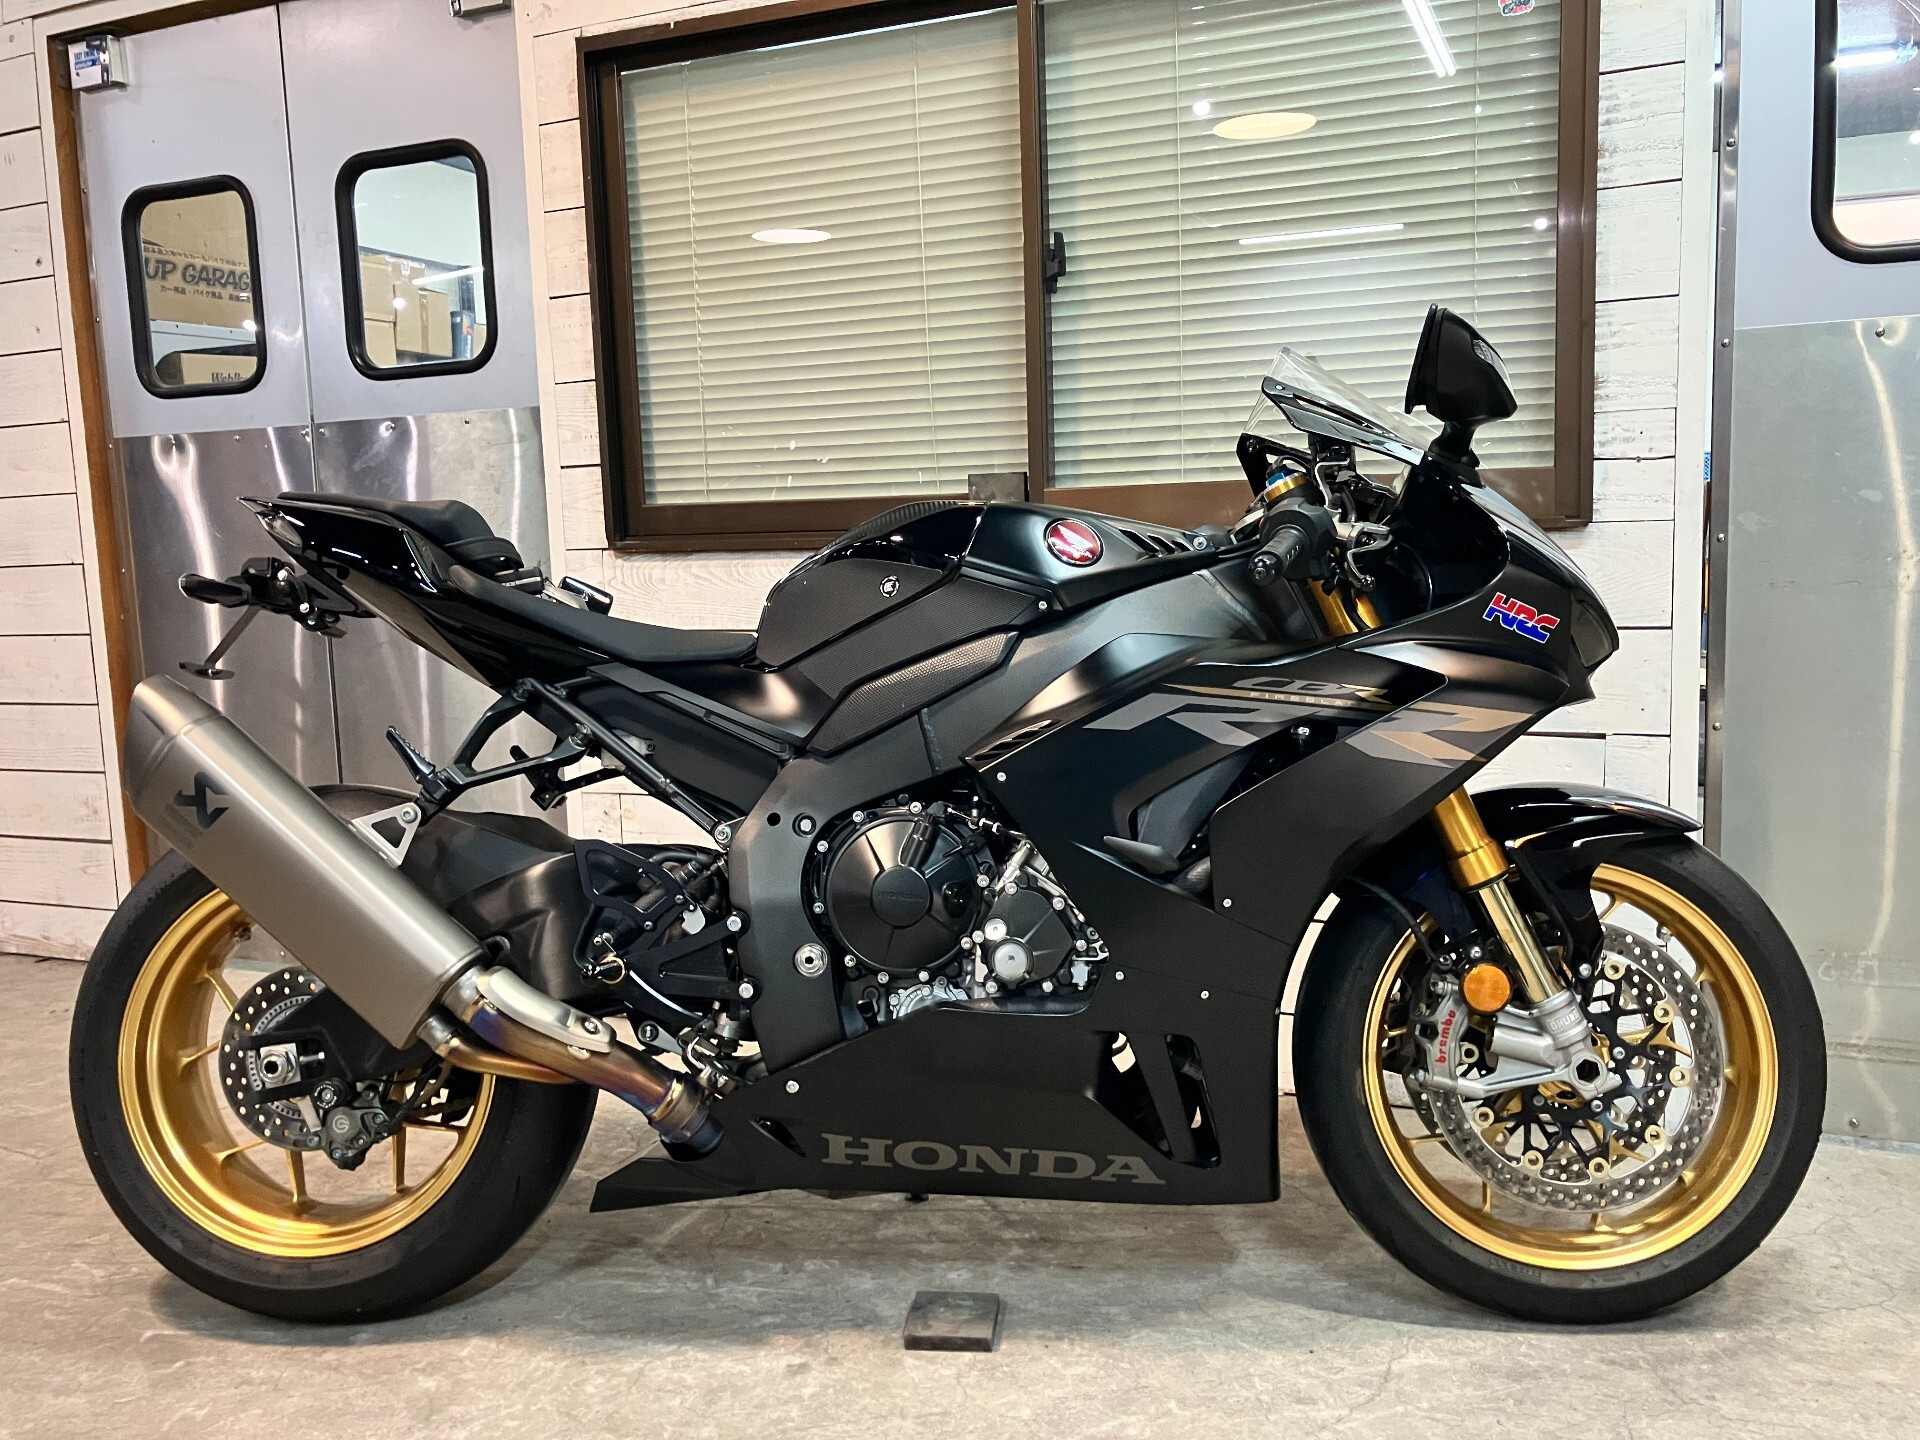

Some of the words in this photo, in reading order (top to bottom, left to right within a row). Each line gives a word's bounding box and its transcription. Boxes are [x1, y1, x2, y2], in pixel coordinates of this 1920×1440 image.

[144, 257, 177, 281] UP
[1482, 591, 1561, 644] HRC
[1231, 676, 1393, 705] CBR
[1434, 1009, 1457, 1064] brembo
[820, 1132, 1167, 1185] HONDA
